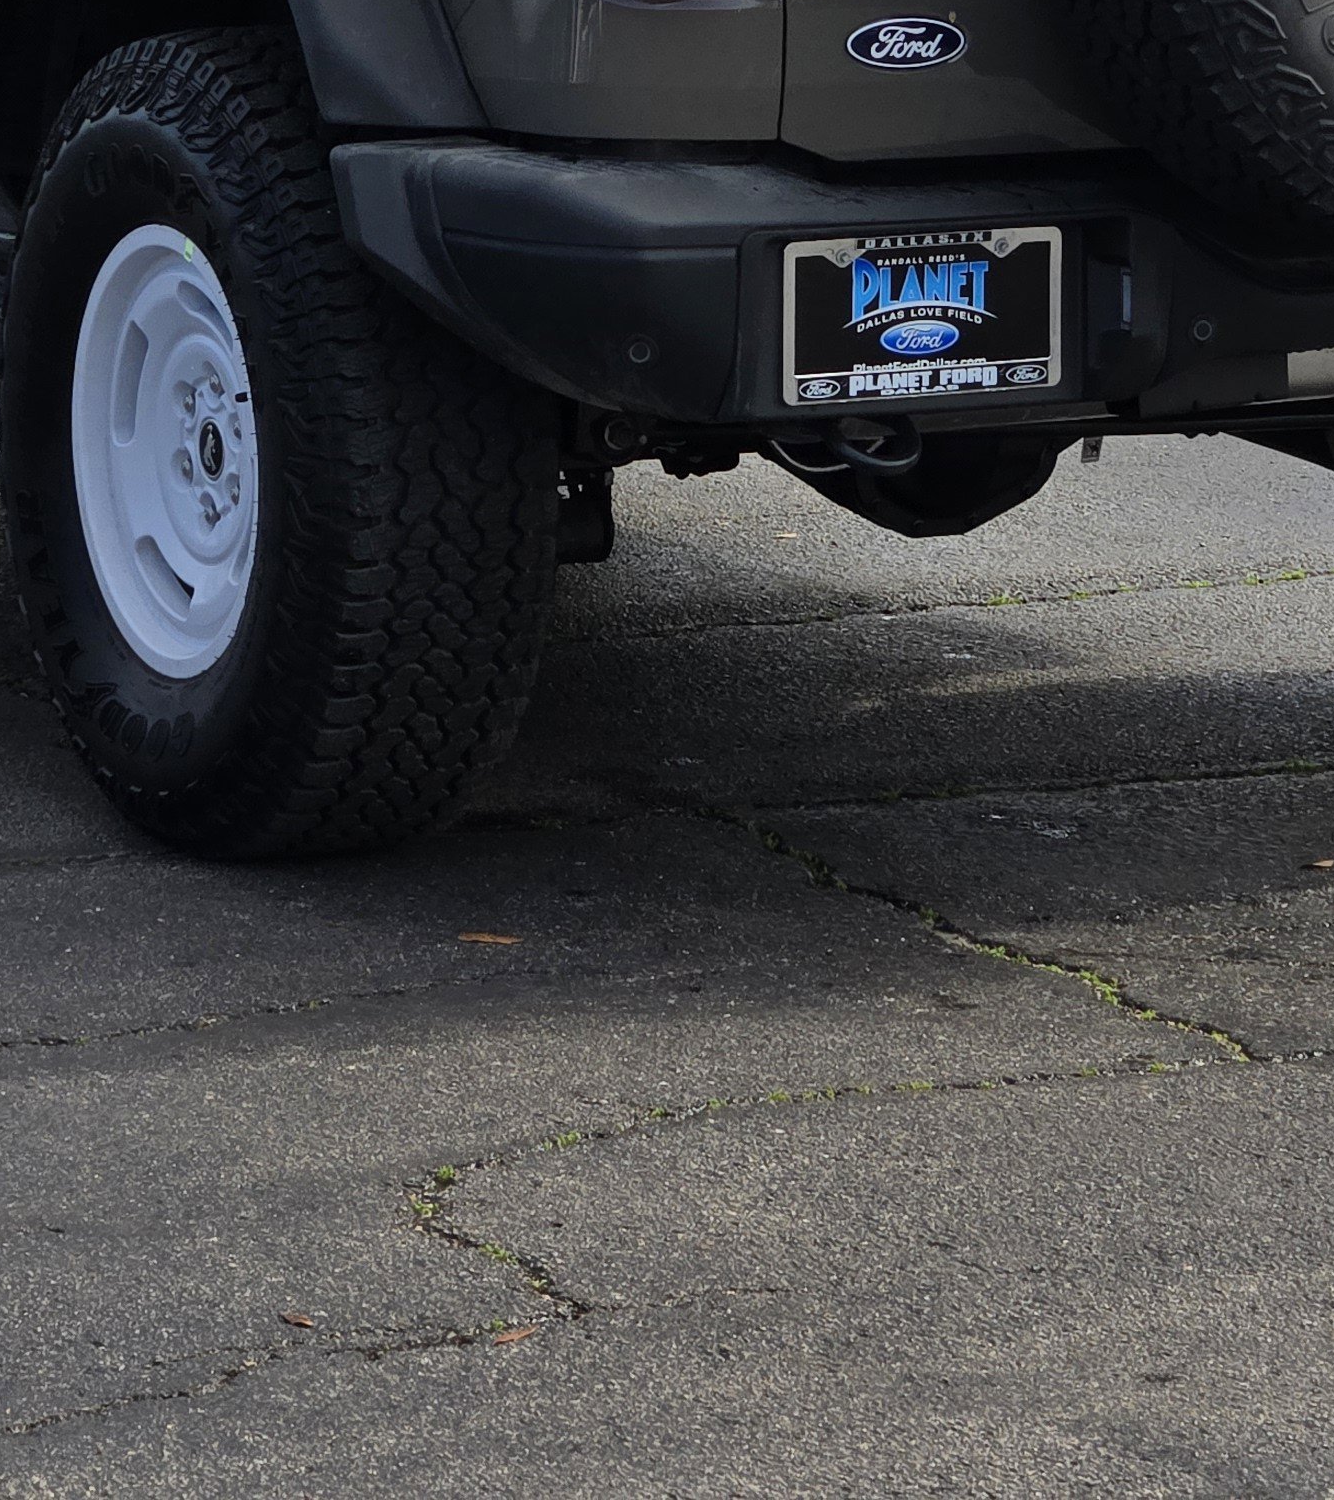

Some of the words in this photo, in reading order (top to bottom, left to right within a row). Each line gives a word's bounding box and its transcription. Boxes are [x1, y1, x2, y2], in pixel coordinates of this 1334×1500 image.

[870, 26, 944, 59] Ford
[960, 231, 984, 243] TX
[877, 257, 924, 267] RANDALL
[852, 257, 989, 322] PLANET
[857, 310, 905, 333] DALLAS
[910, 307, 943, 318] LOVE
[948, 308, 983, 325] FIELD
[896, 327, 944, 350] Ford
[848, 370, 933, 397] PLANET
[939, 365, 998, 387] FORD
[1014, 366, 1040, 381] Ford
[807, 381, 833, 398] Ford
[880, 384, 960, 396] DALLAS
